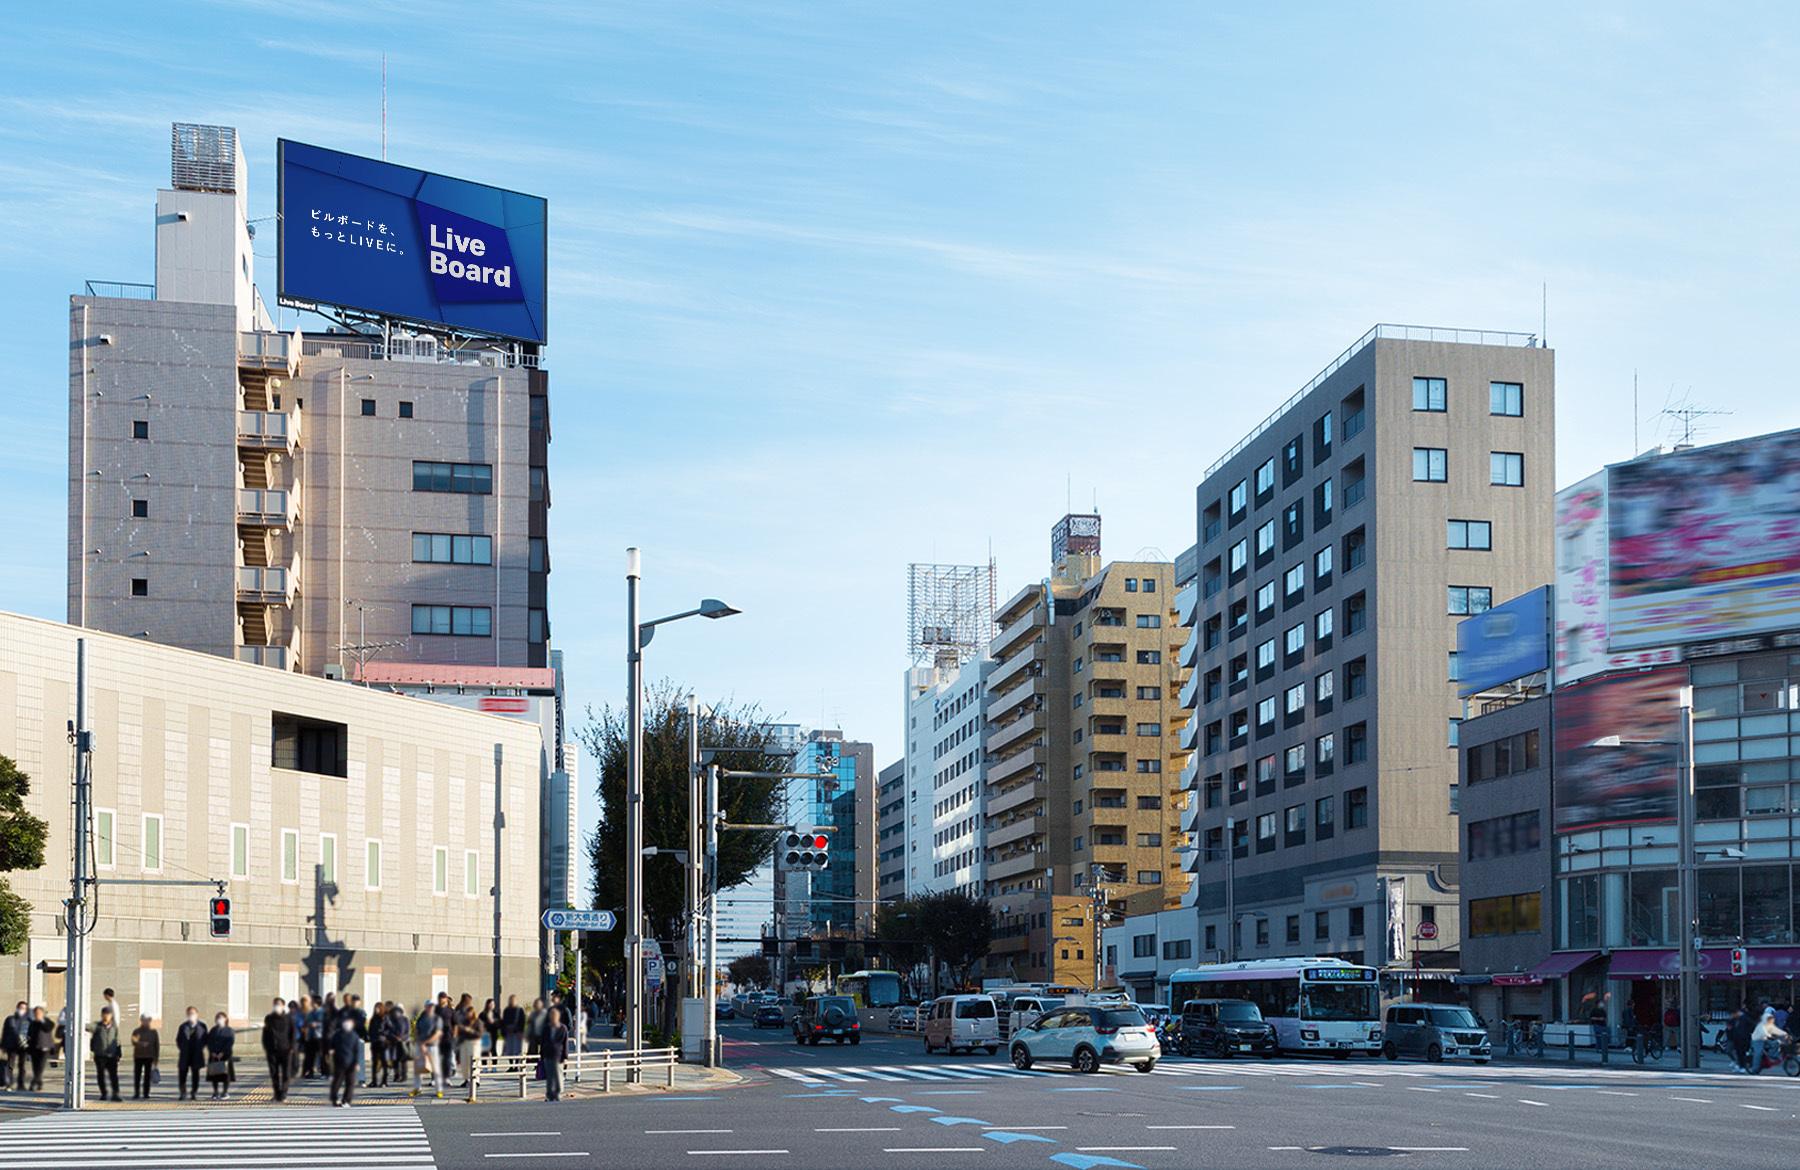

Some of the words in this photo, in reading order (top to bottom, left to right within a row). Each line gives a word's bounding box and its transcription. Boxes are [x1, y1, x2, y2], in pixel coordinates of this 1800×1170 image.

[311, 209, 395, 237] ビルボードを、
[311, 226, 404, 256] もっとLIVEに。
[430, 223, 486, 256] Live
[430, 249, 511, 288] Board
[294, 300, 316, 311] Board
[649, 961, 657, 971] P
